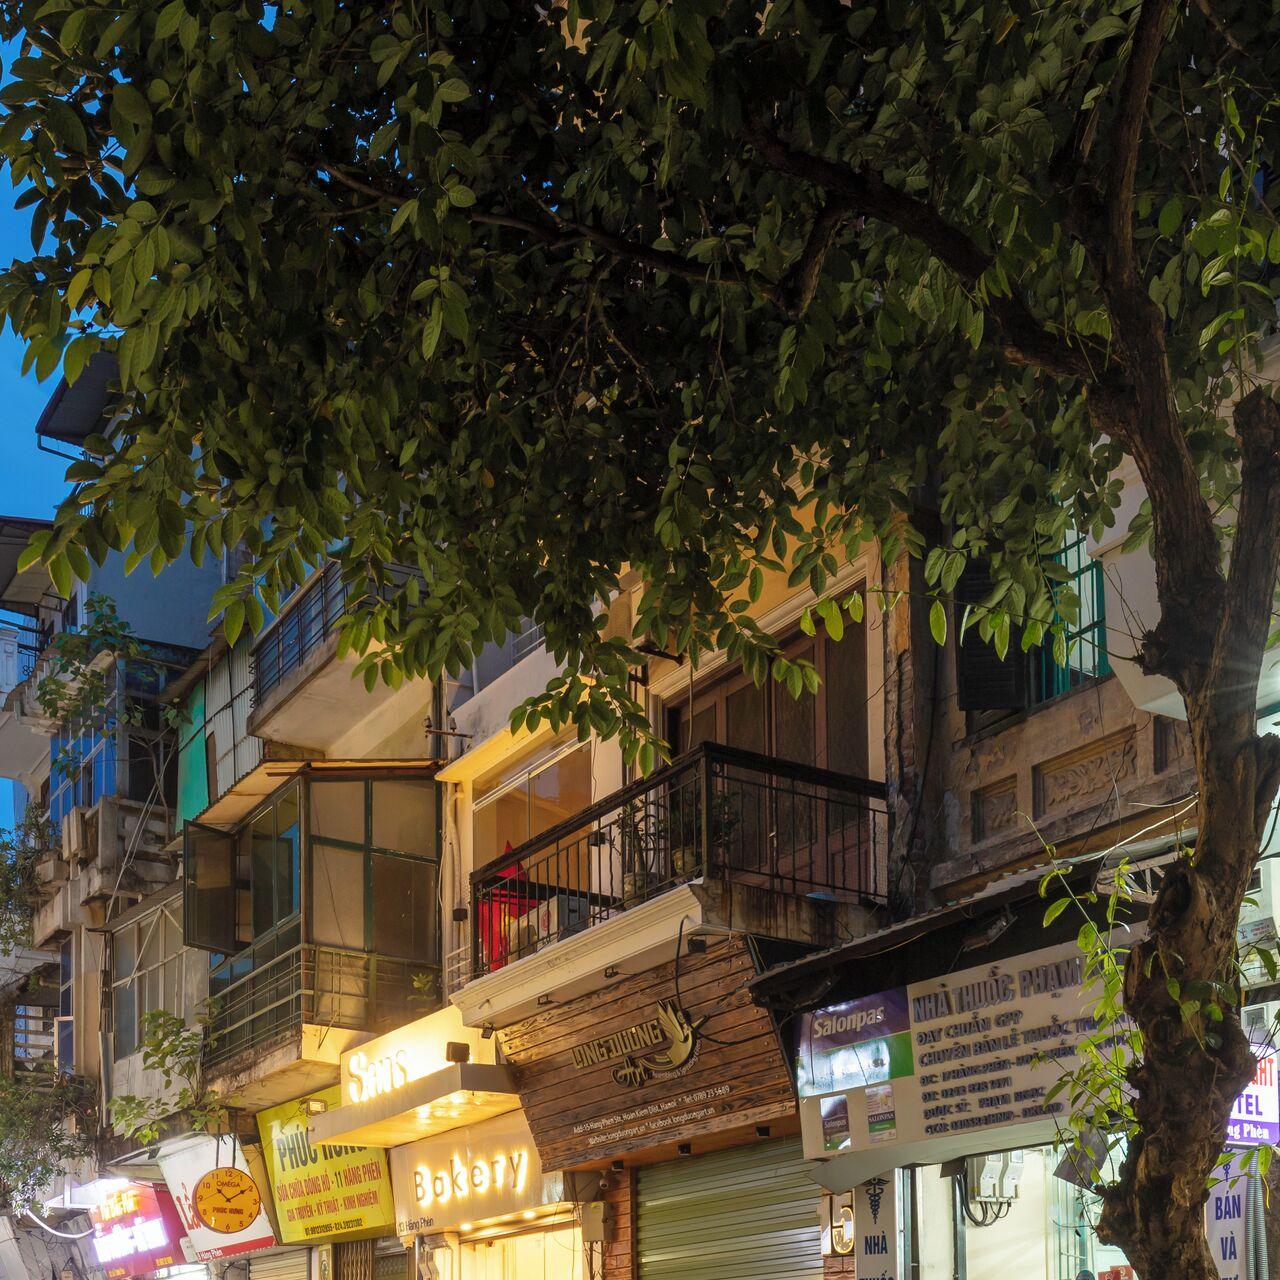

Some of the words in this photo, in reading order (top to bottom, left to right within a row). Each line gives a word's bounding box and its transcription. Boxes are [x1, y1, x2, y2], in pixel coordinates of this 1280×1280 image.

[912, 982, 950, 1023] NHÀ
[814, 1006, 886, 1039] Salonpas
[1243, 1122, 1270, 1140] Phèn
[1215, 1192, 1242, 1221] BÁN
[864, 1230, 889, 1256] NHÀ
[1220, 1233, 1238, 1261] VÀ
